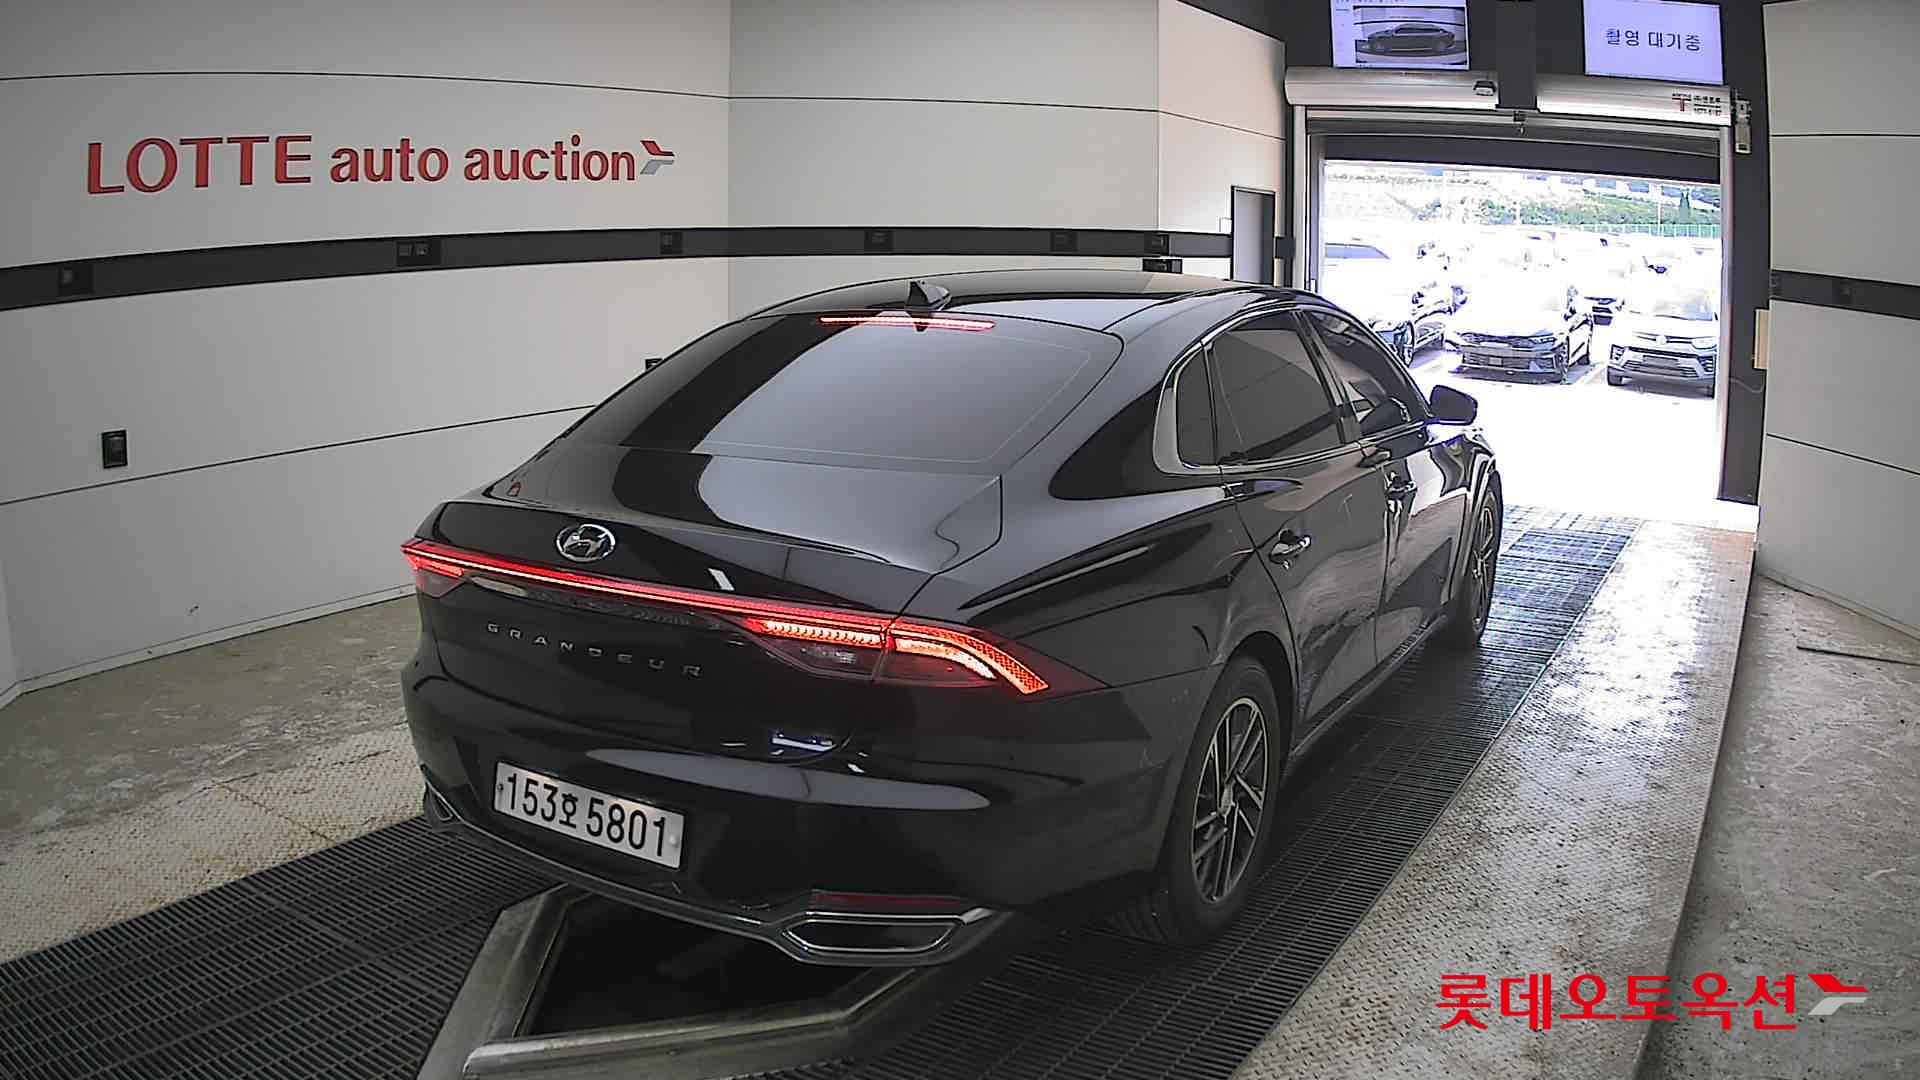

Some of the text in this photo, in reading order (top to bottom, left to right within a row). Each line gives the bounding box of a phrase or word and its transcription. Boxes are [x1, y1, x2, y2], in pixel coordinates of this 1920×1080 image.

[1648, 31, 1701, 51] 대기중
[88, 134, 636, 195] LOTTE auto auction
[487, 623, 701, 677] GRANDEUR
